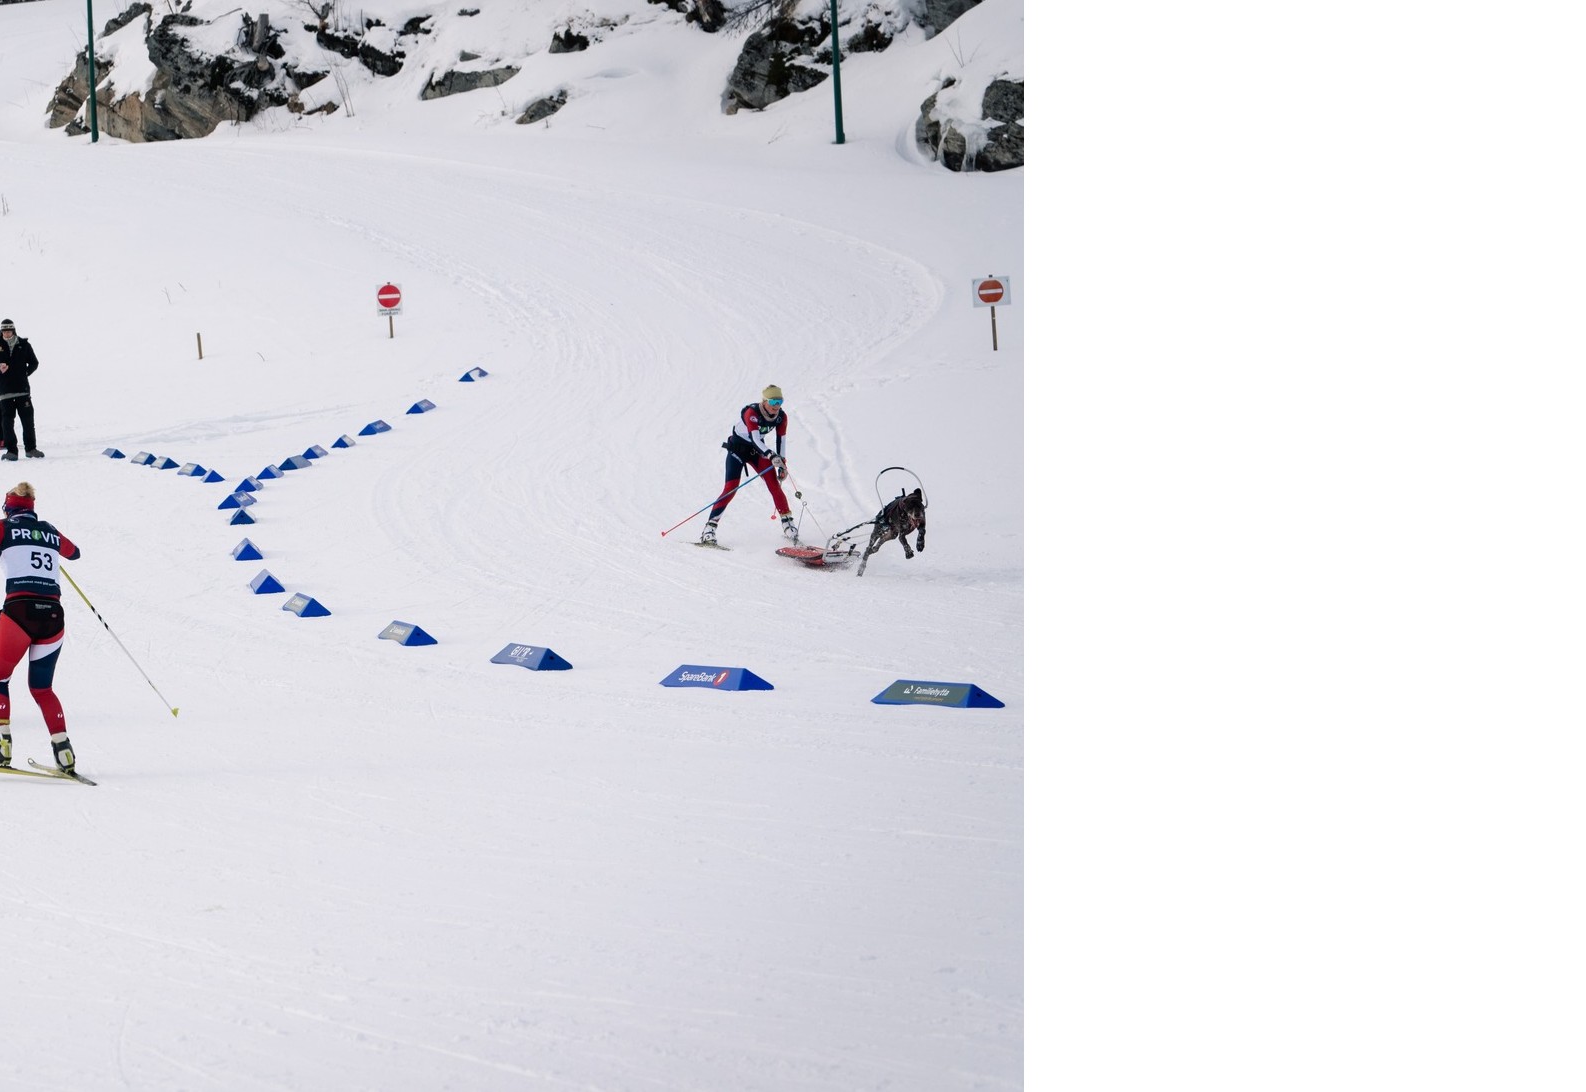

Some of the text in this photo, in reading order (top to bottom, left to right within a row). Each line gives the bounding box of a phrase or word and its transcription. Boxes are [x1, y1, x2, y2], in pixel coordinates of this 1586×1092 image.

[11, 528, 60, 546] PROVIT
[30, 551, 53, 571] 53
[679, 671, 716, 683] SpareBank
[914, 686, 950, 698] Familiehytta
